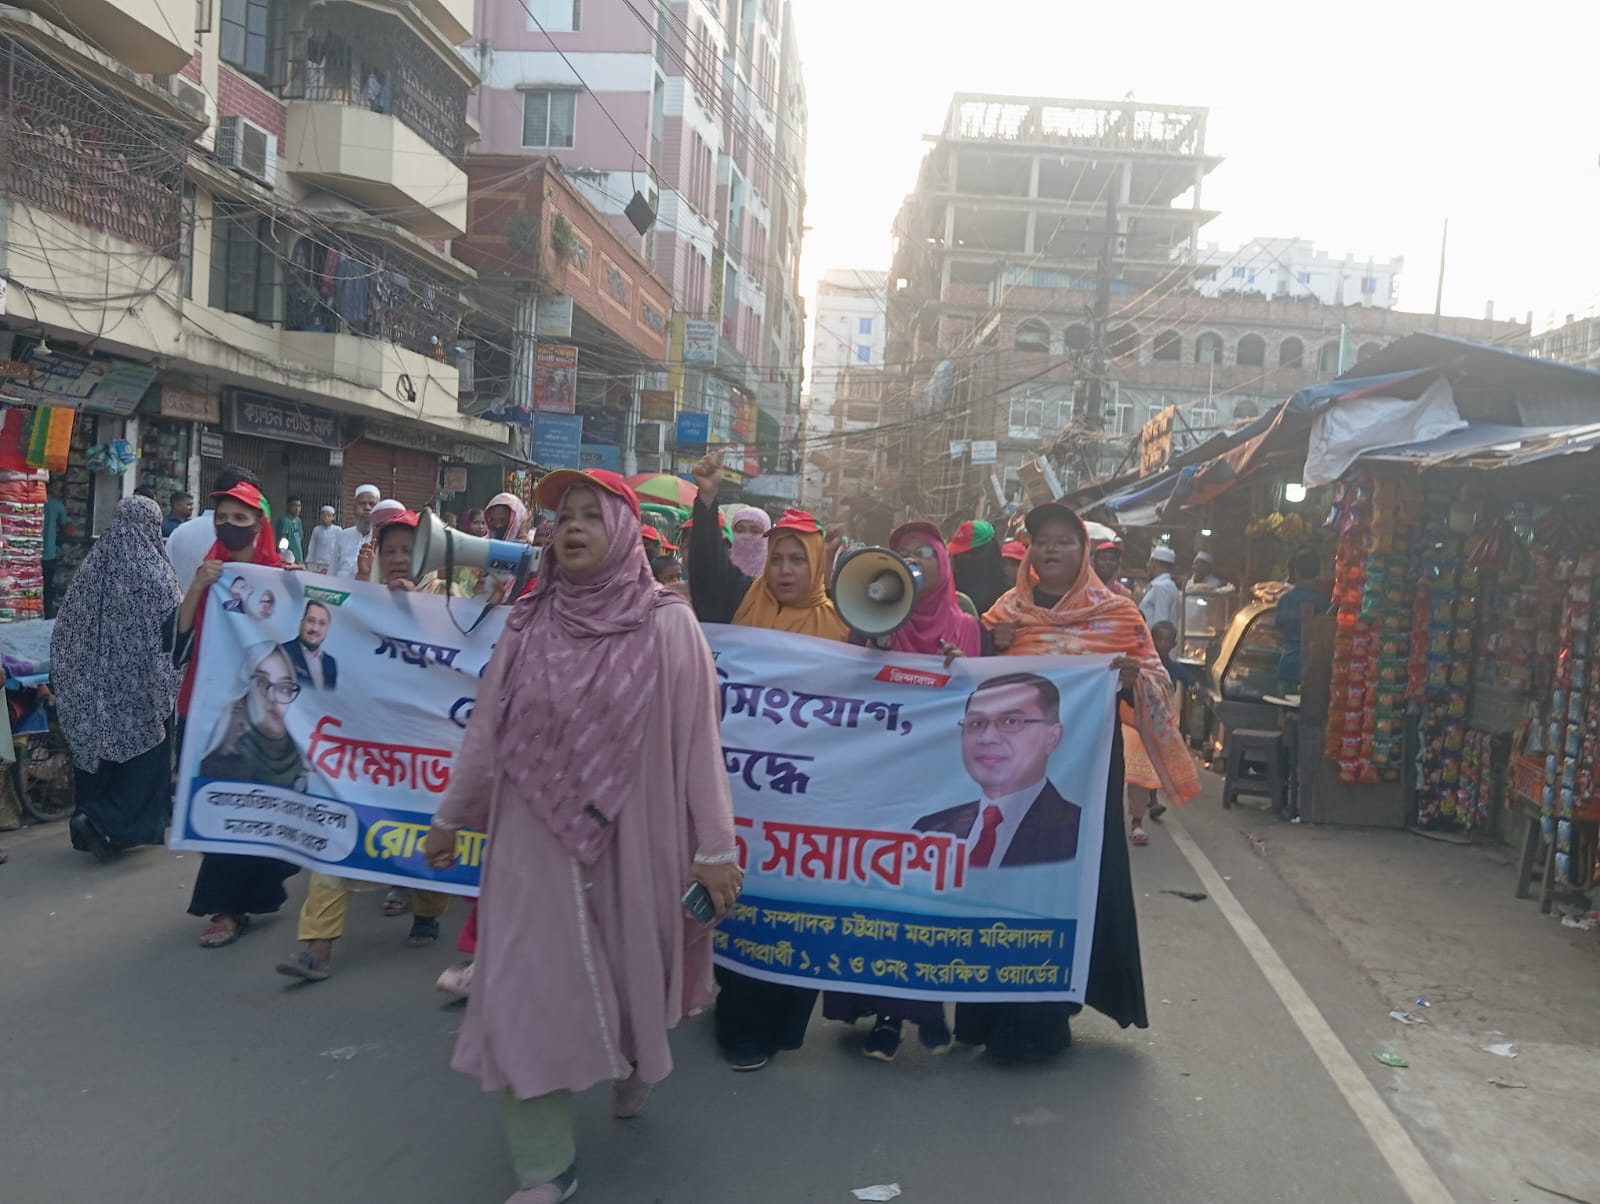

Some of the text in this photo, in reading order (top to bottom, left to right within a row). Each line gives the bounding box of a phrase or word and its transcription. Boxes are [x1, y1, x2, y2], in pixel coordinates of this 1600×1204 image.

[889, 667, 937, 688] জিন্দাবাদ
[307, 715, 452, 793] বিক্ষোভ
[762, 909, 837, 934] সম্পাদক
[841, 913, 899, 941] চট্টগ্রাম
[904, 923, 975, 947] মহানগর
[978, 922, 1054, 949] মহিলাদল
[827, 953, 842, 976] ২
[850, 955, 865, 974] ও
[871, 959, 909, 983] ৩নং
[915, 958, 991, 985] সংরক্ষিত
